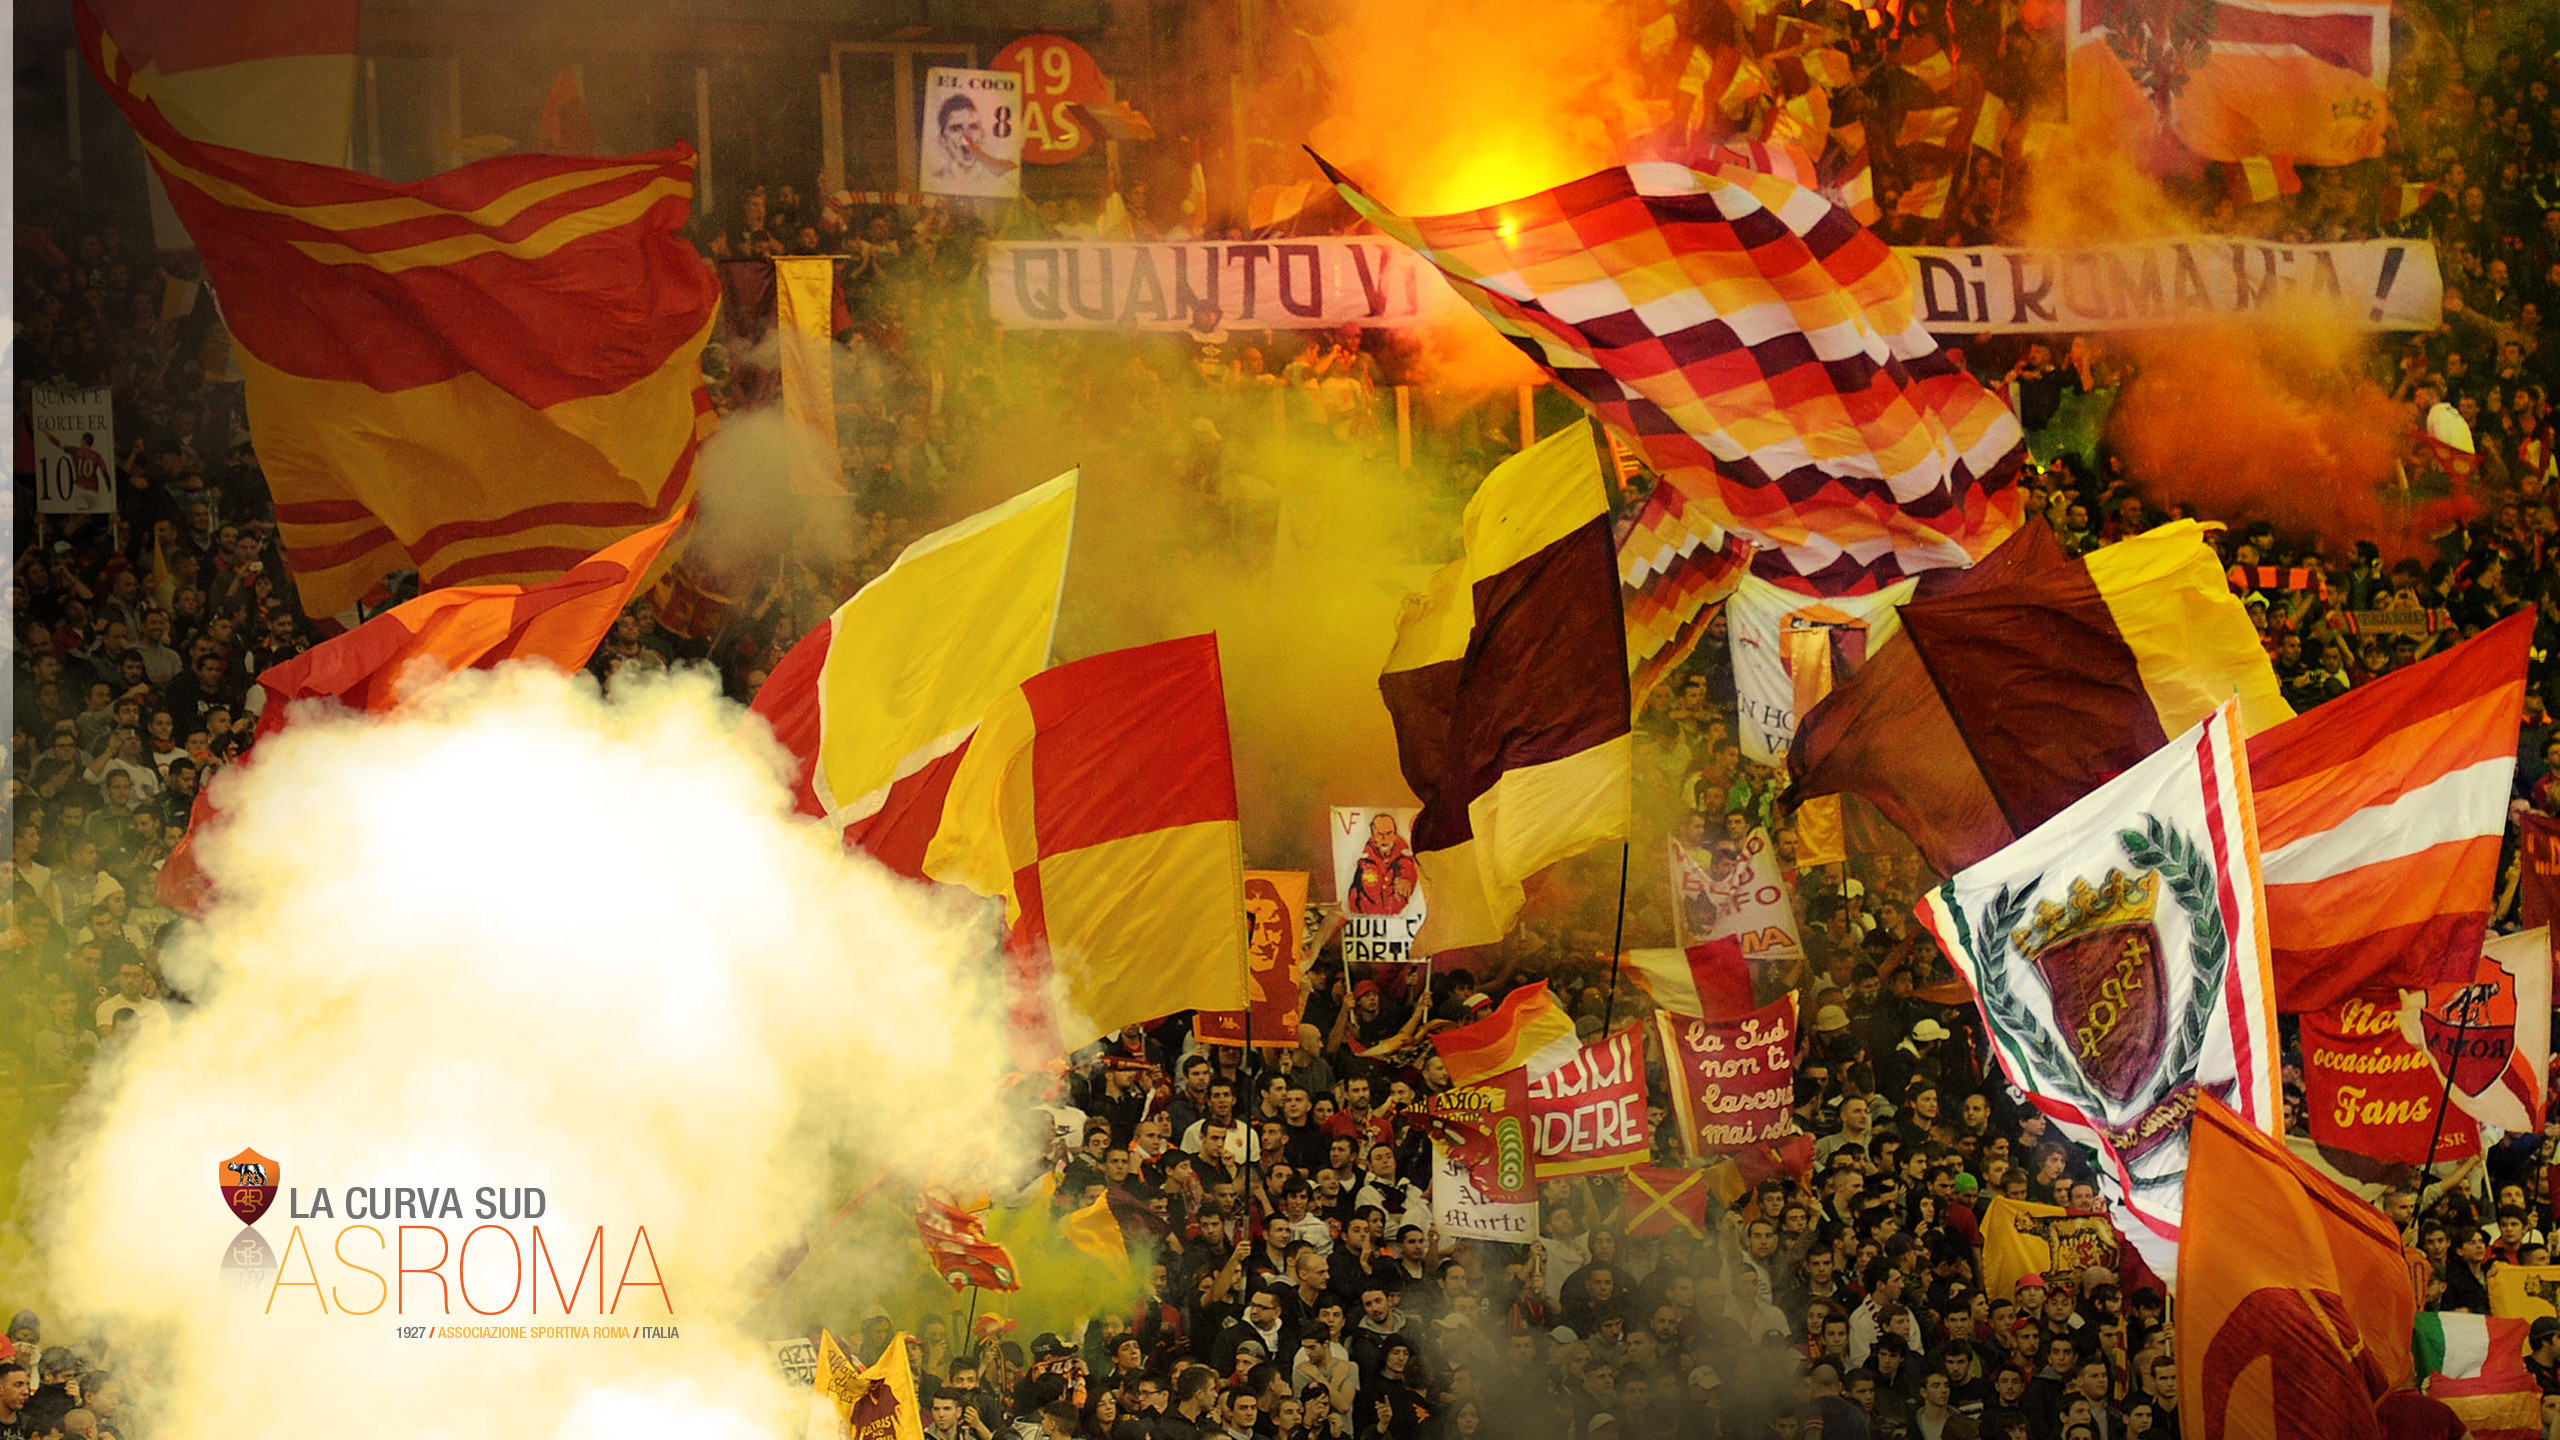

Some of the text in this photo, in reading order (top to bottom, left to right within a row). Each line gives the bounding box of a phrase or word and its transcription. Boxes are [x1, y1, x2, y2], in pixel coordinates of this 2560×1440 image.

[937, 75, 1015, 91] EL COCO
[1015, 46, 1072, 95] 19
[993, 106, 1012, 138] 8
[1007, 244, 1324, 320] QUANTO
[2004, 242, 2214, 323] ROMA
[88, 415, 106, 431] ER
[40, 456, 74, 501] 10
[1735, 1017, 1789, 1050] Sud
[2341, 997, 2401, 1036] No
[1700, 1044, 1790, 1078] non ti
[2333, 1085, 2431, 1128] Fans
[1701, 1120, 1757, 1145] mai
[1444, 1208, 1527, 1233] Morte
